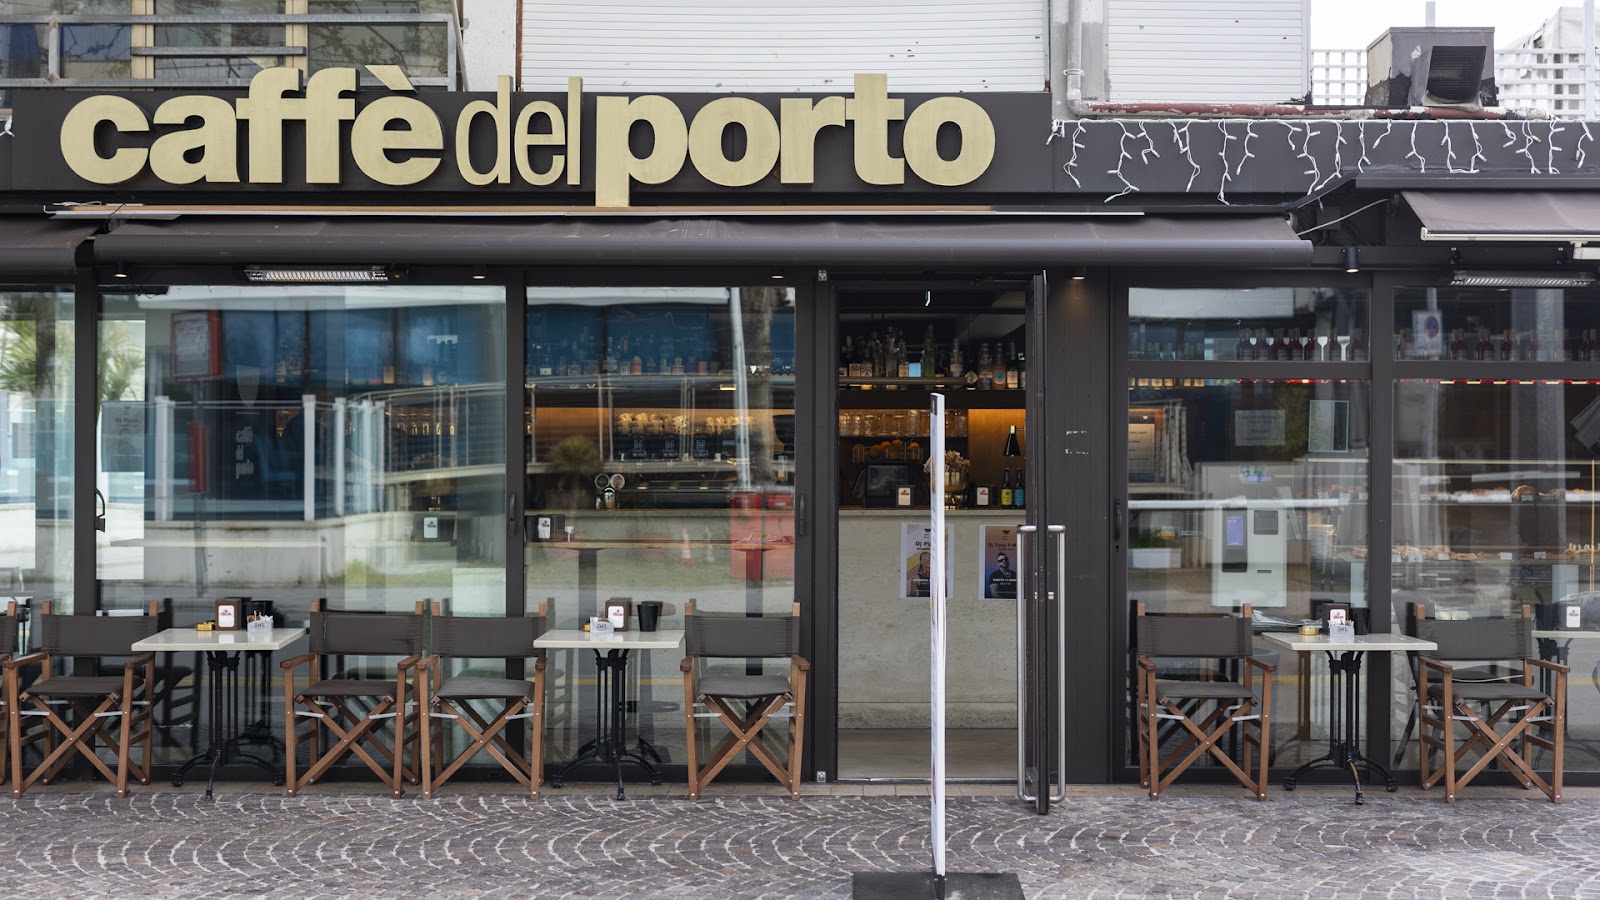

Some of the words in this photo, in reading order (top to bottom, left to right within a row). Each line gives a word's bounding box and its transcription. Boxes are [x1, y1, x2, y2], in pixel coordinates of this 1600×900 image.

[60, 64, 444, 186] caffè
[455, 75, 583, 186] del
[595, 73, 996, 207] porto
